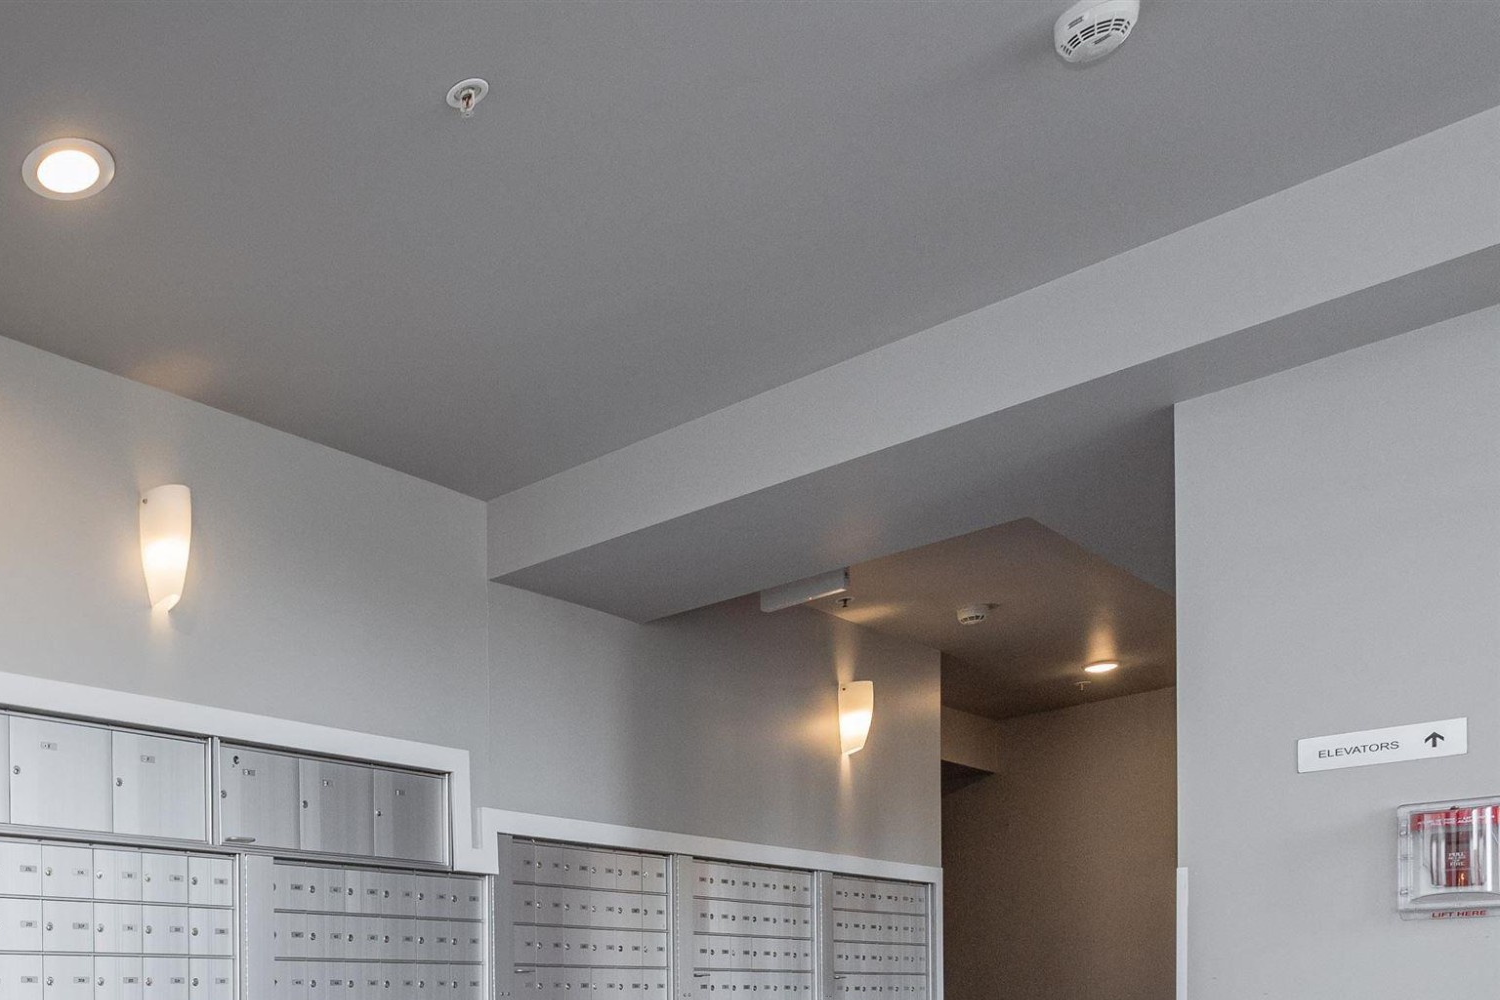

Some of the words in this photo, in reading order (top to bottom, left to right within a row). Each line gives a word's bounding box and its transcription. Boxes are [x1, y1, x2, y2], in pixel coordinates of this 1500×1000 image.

[1318, 741, 1400, 759] ELEVATORS
[1432, 911, 1454, 919] LIFT
[1457, 910, 1487, 918] HERE
